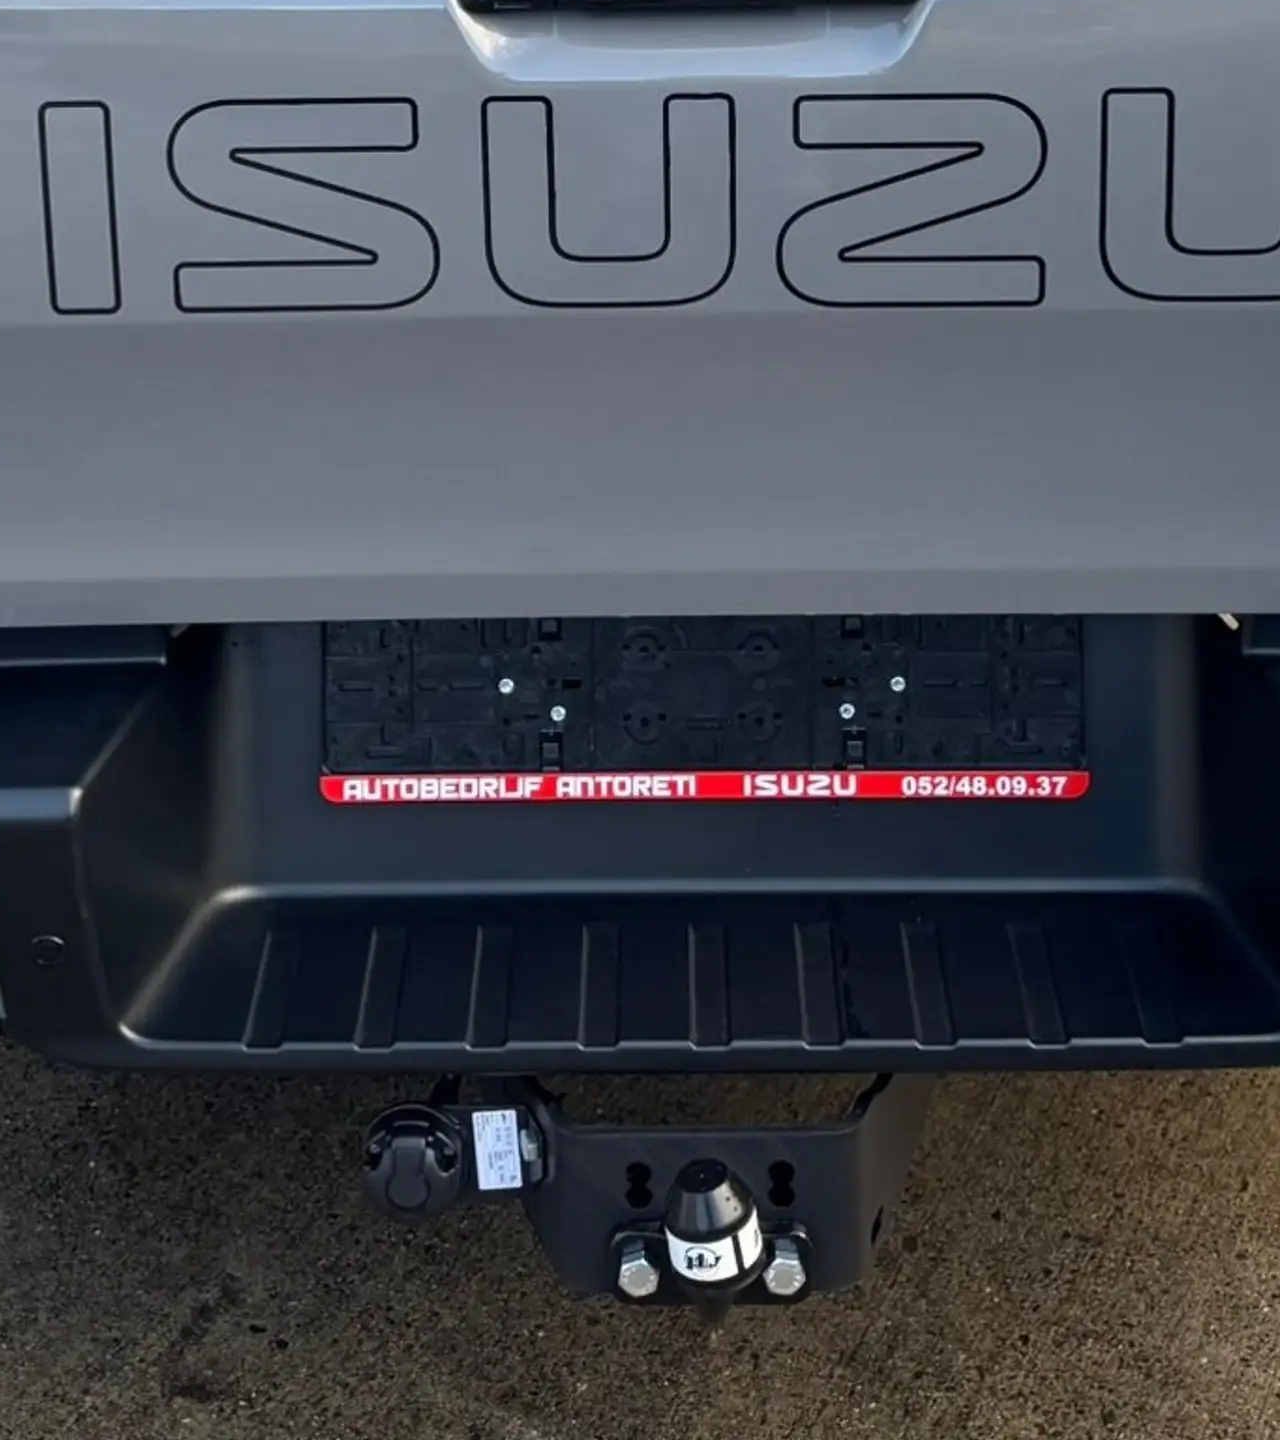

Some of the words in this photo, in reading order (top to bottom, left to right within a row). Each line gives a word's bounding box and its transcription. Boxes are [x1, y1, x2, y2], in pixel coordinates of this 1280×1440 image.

[343, 775, 542, 801] AUTOBEDRIJF
[555, 774, 698, 798] ANTORETI
[743, 775, 858, 797] ISUZU
[900, 774, 1069, 796] 052/48.09.37
